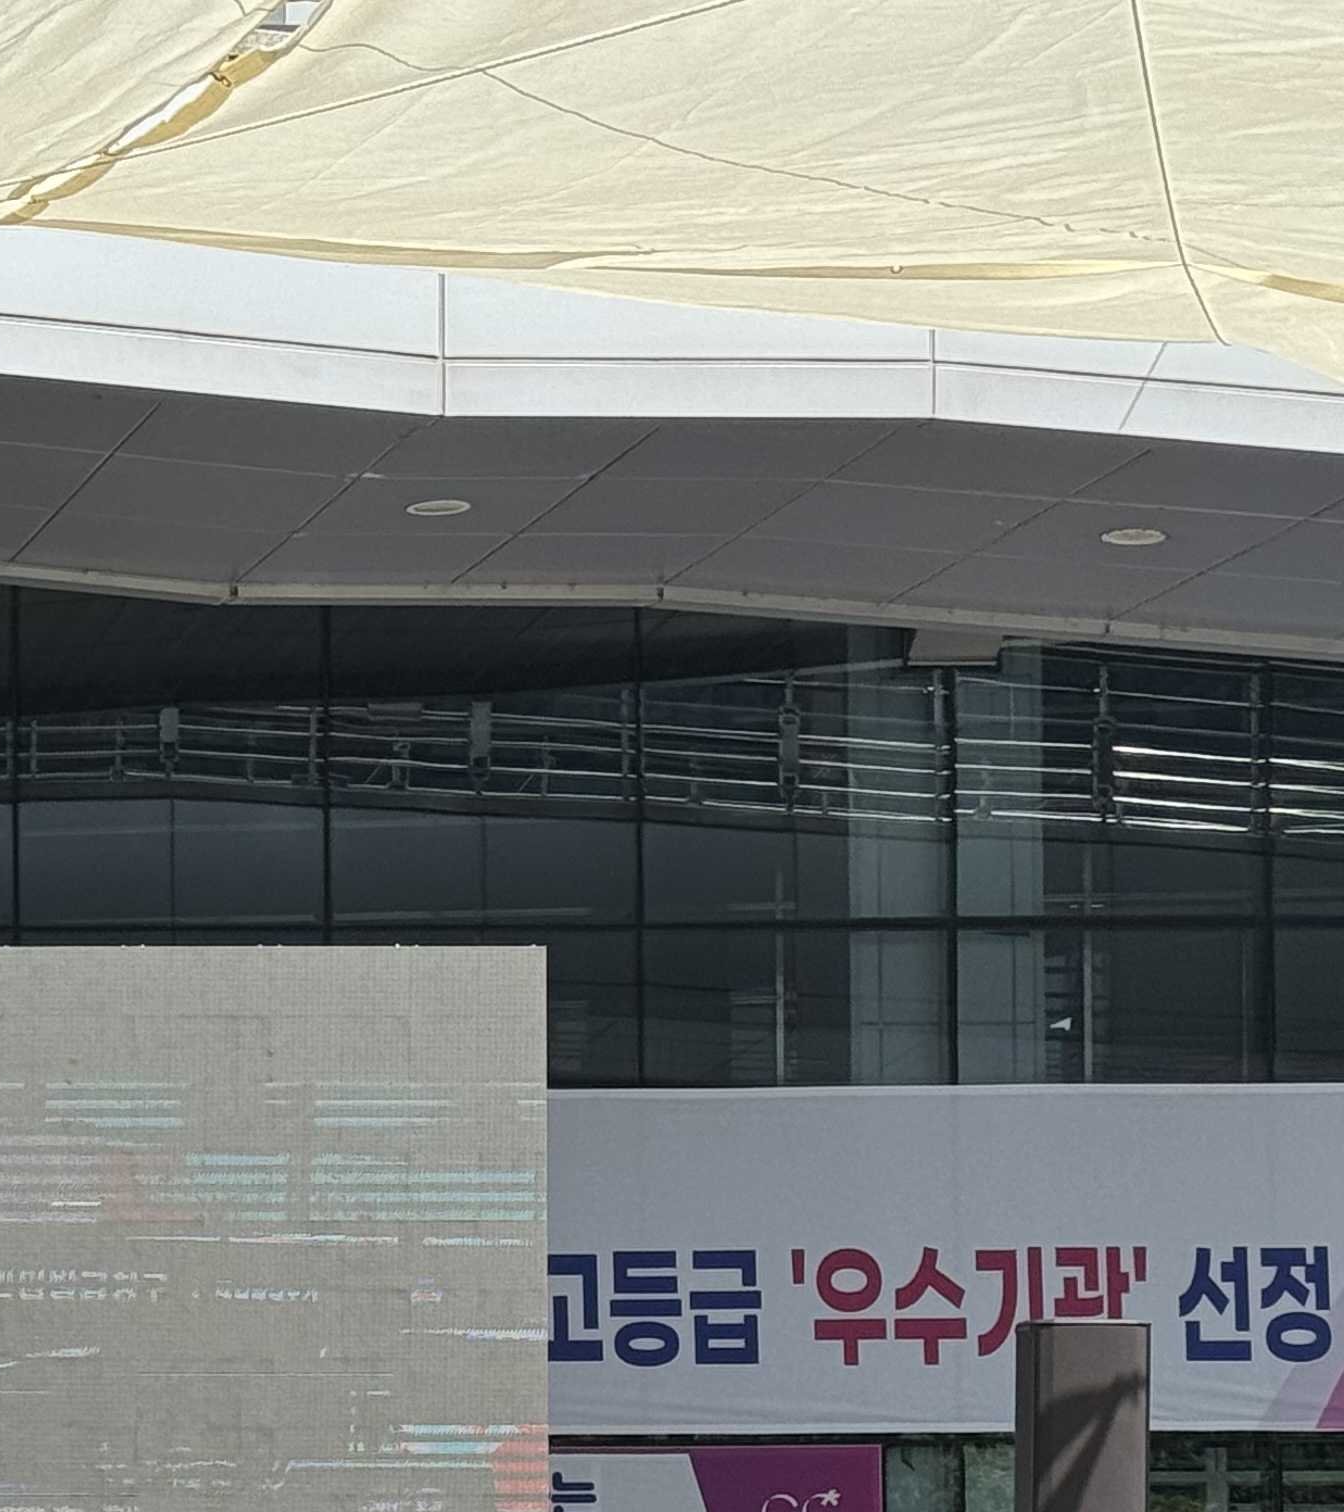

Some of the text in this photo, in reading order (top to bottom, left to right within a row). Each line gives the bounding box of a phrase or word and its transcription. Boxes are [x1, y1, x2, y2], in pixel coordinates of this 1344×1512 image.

[548, 1246, 1332, 1366] 고등급 '우수기관' 선정
